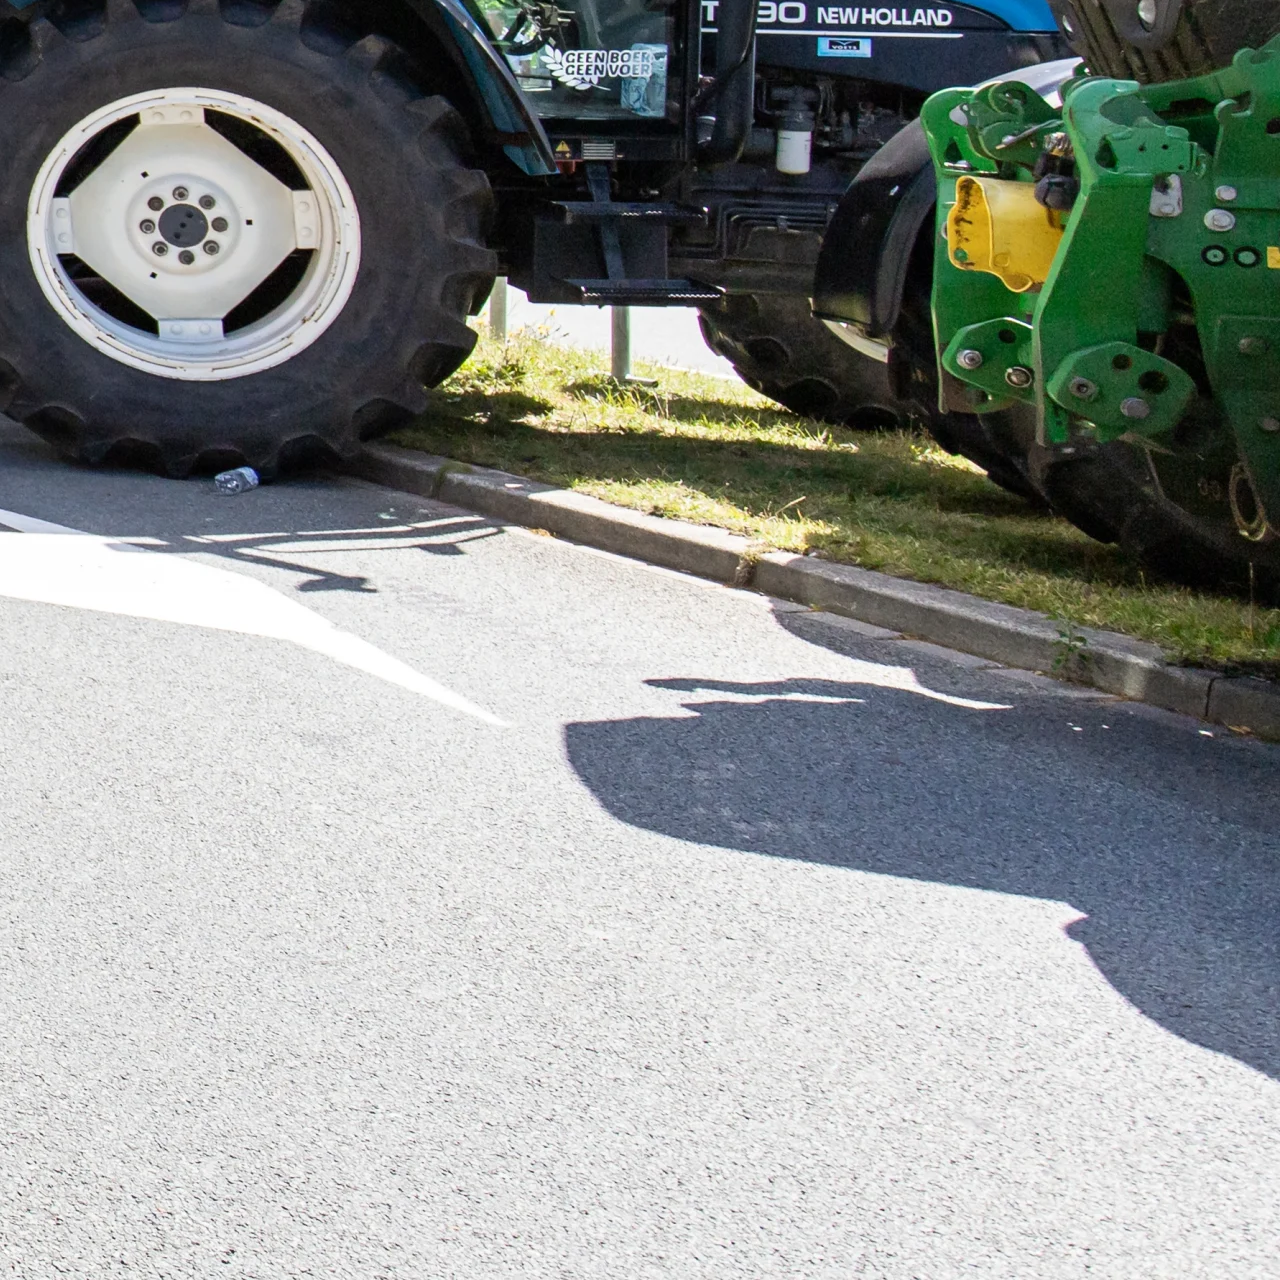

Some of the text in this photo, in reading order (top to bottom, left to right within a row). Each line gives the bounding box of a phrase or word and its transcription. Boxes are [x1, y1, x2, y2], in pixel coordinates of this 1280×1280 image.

[701, 1, 952, 26] T90 NEW HOLLAND
[565, 52, 650, 63] GEEN BOER
[565, 64, 650, 76] GEEN VOER
